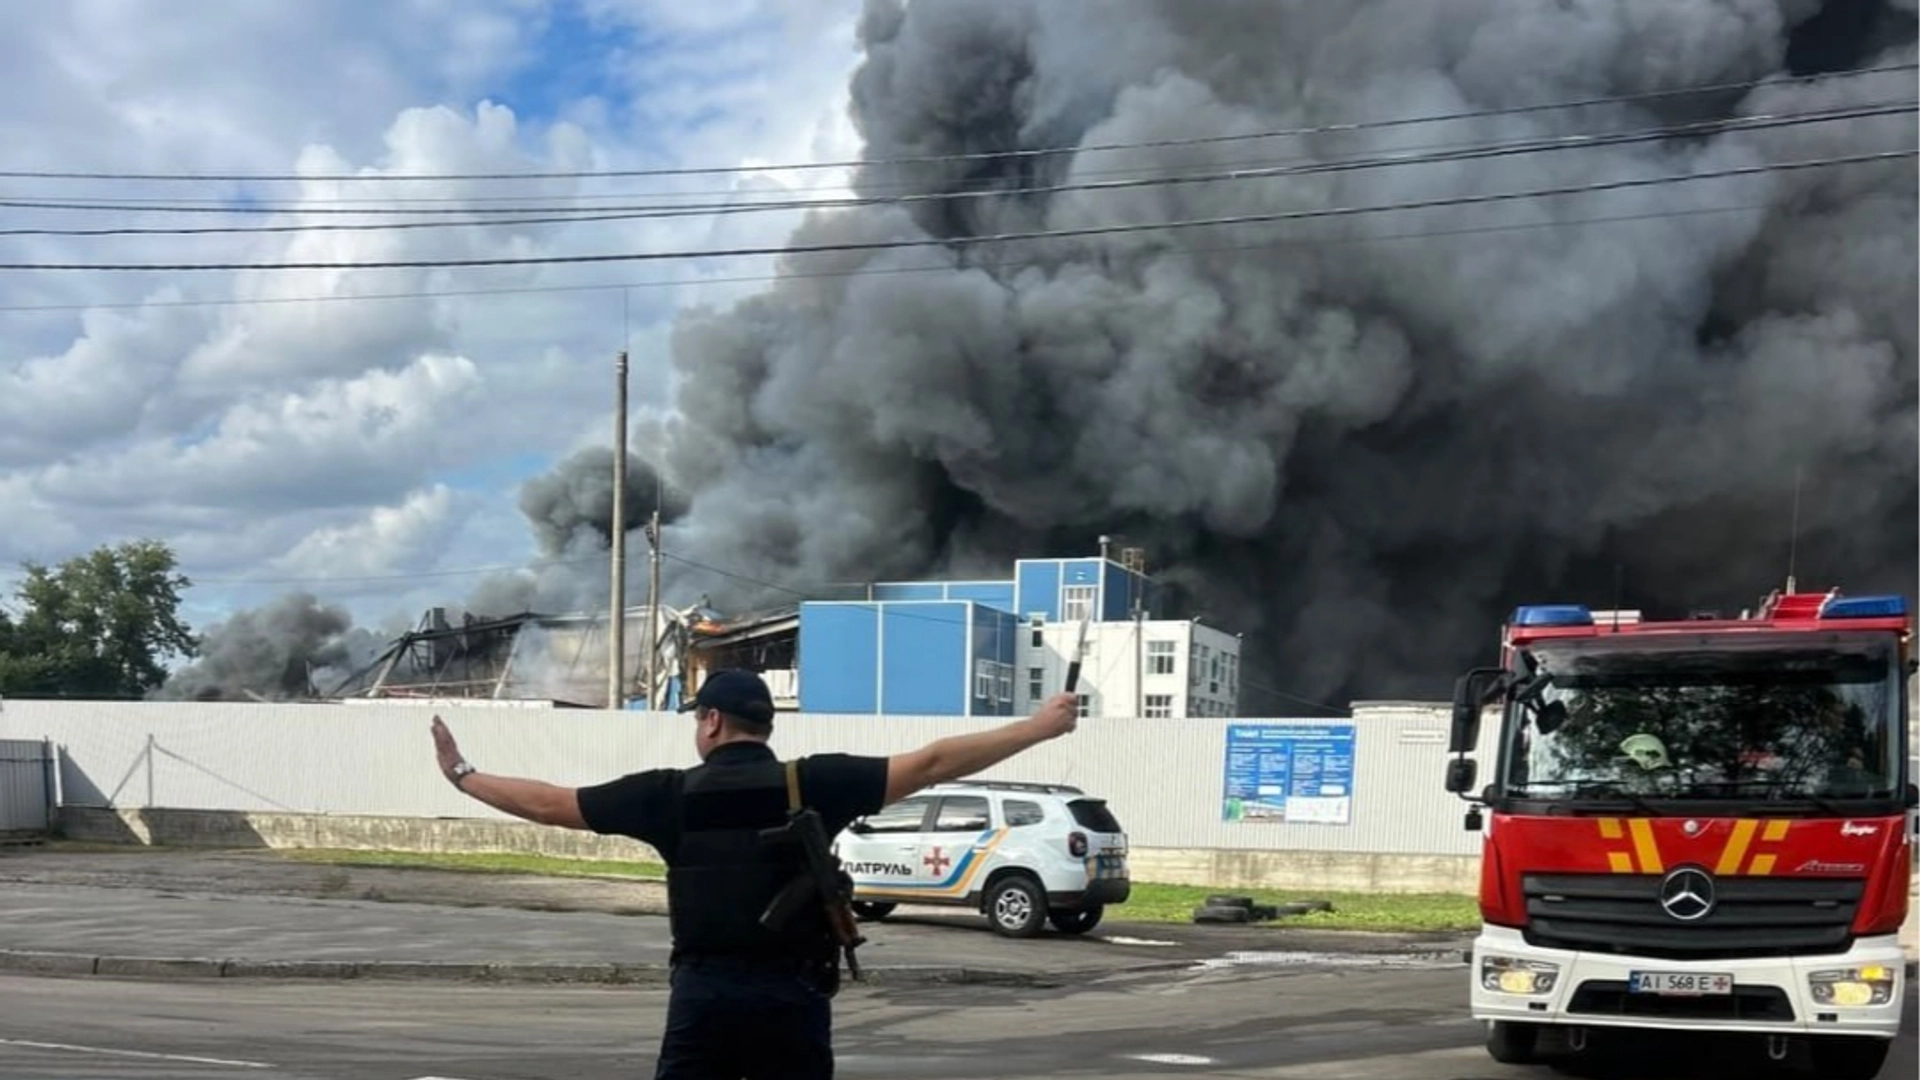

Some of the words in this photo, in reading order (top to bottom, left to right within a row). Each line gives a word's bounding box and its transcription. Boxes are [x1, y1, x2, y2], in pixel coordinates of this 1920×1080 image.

[845, 861, 912, 876] ПАТРУЛЬ
[1641, 975, 1660, 989] AI
[1668, 975, 1695, 990] 568
[1699, 976, 1711, 991] E
